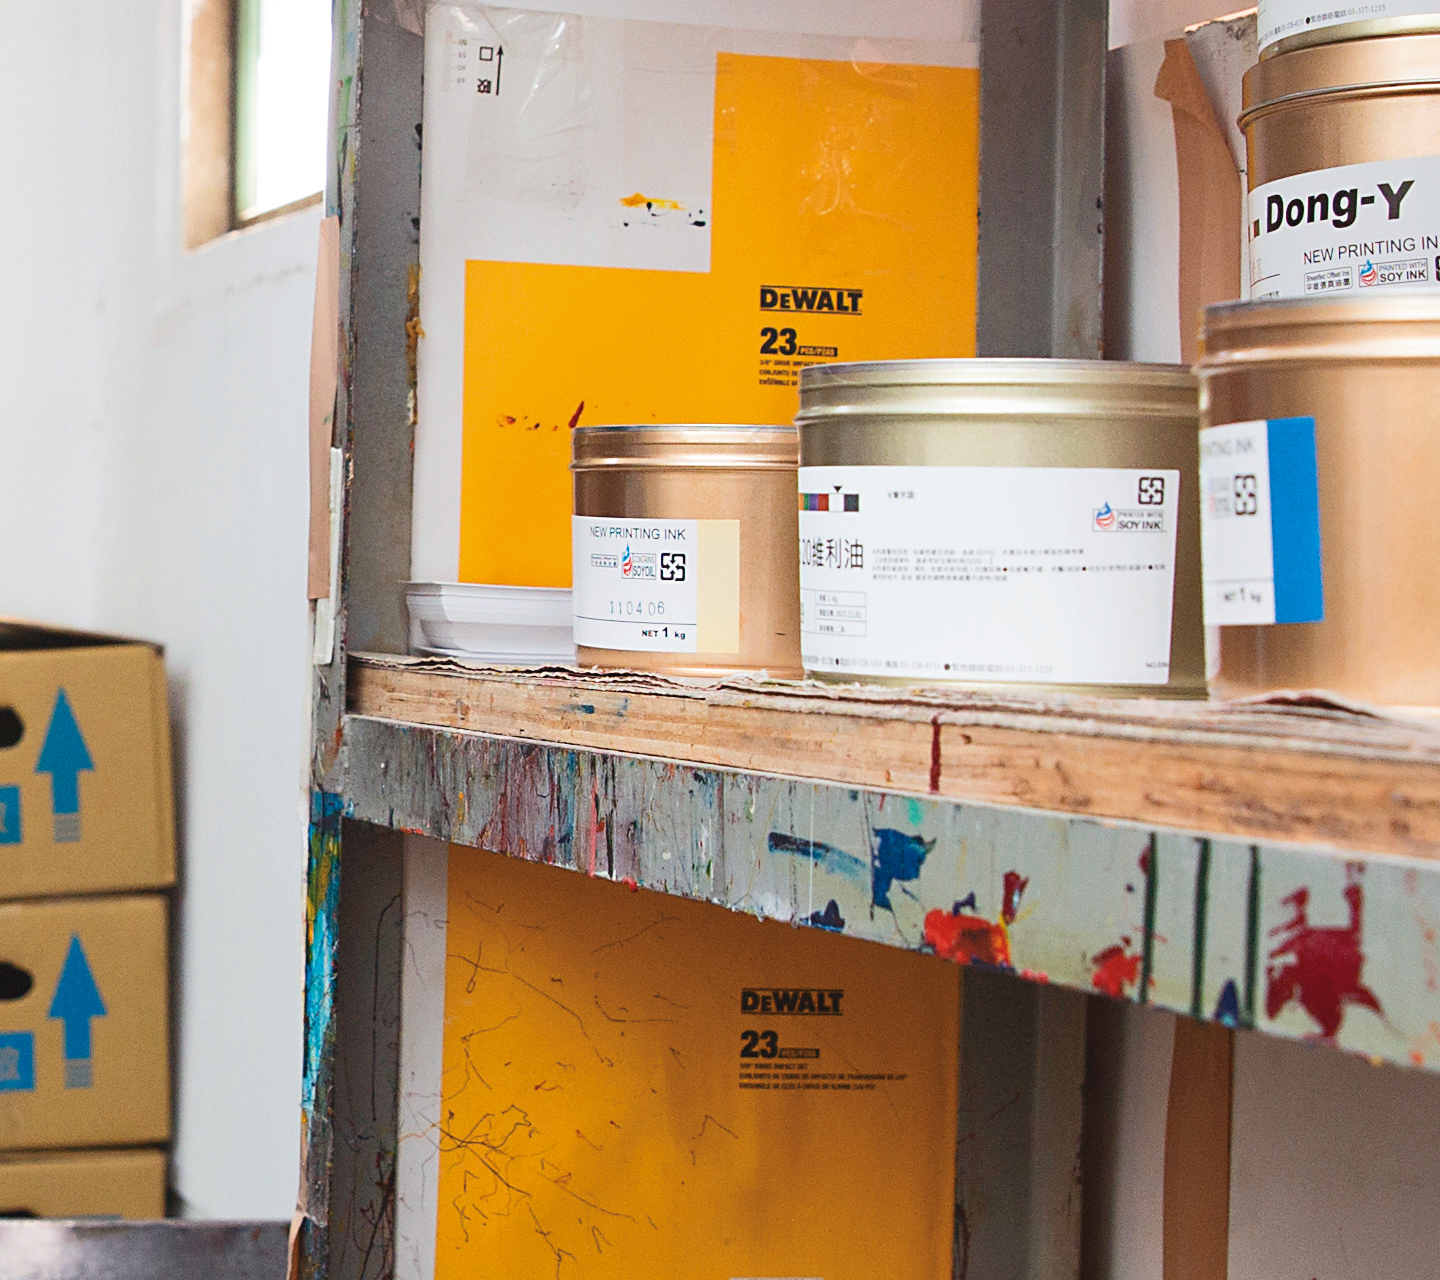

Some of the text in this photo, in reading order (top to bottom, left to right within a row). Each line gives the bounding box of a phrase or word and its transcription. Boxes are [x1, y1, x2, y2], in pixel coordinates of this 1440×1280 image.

[1266, 180, 1415, 234] Dong-Y
[1303, 247, 1334, 266] NEW
[1338, 237, 1415, 260] PRINTING
[1409, 261, 1427, 270] WITH
[1380, 269, 1427, 283] SOY INK
[760, 326, 797, 355] 23
[1118, 520, 1161, 530] SOY INK
[590, 526, 686, 540] NEW PRINTING INK
[633, 565, 656, 577] SOYOIL
[641, 627, 686, 640] NET 1 kg
[740, 1030, 779, 1058] 23
